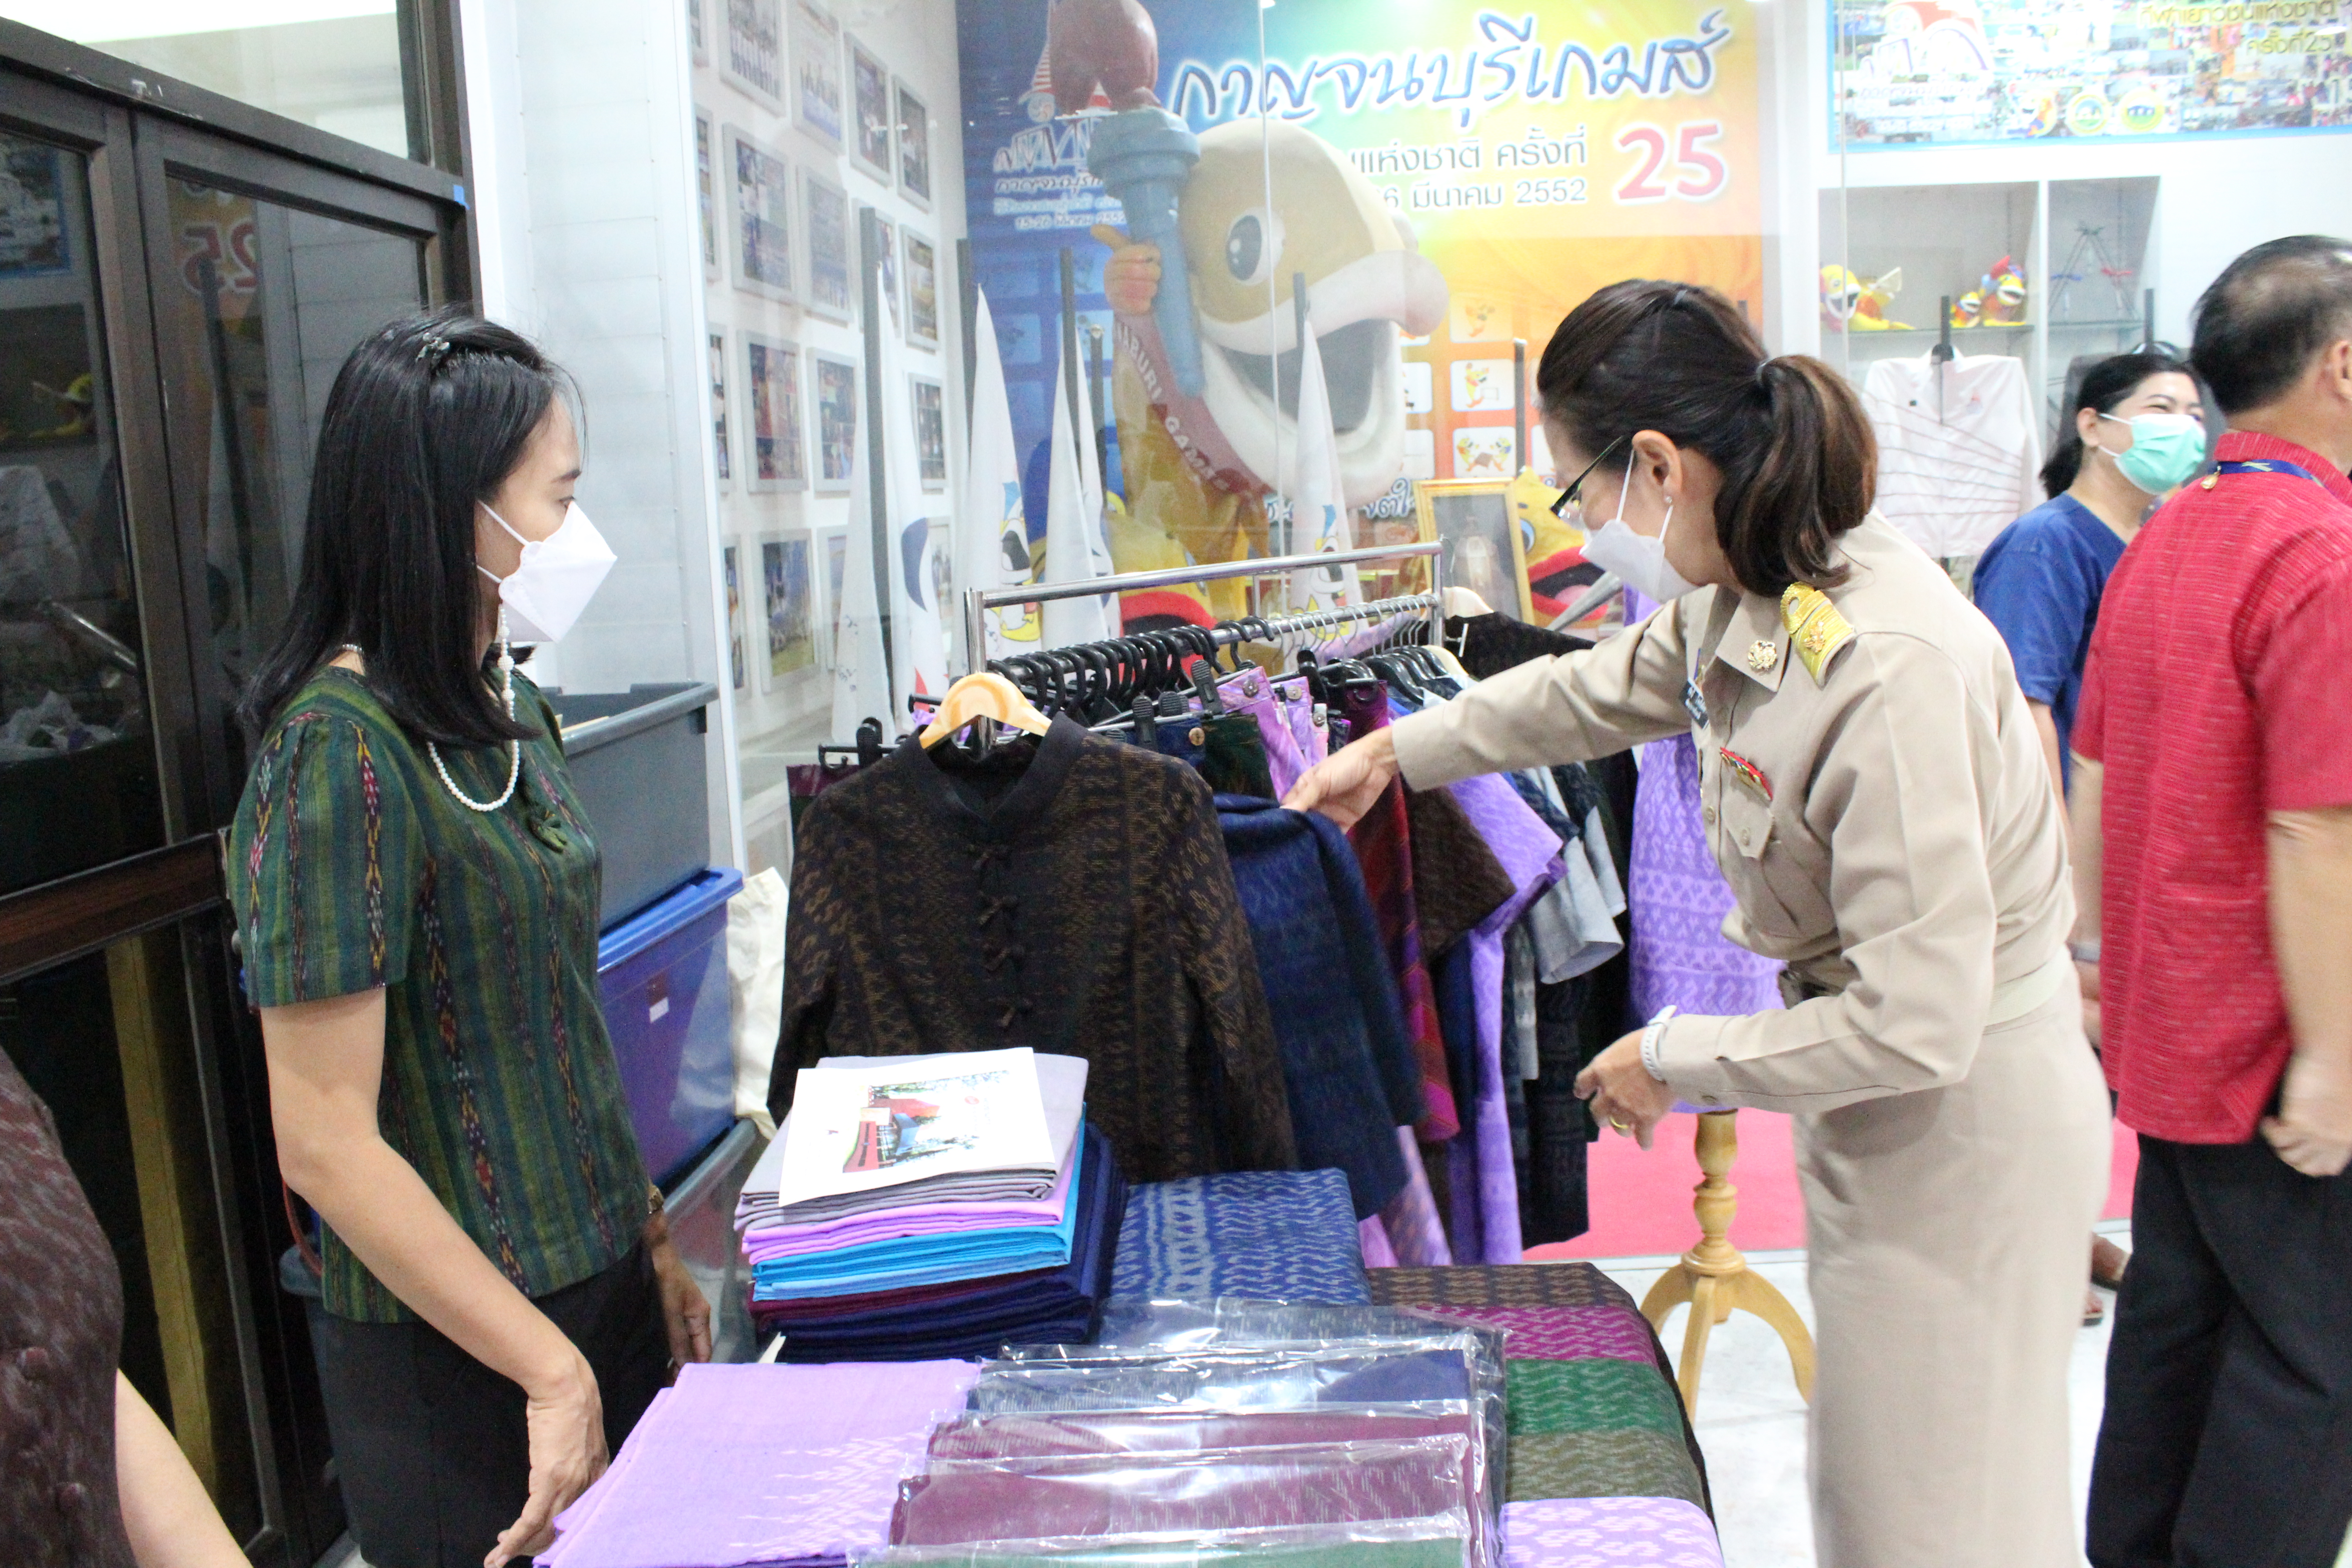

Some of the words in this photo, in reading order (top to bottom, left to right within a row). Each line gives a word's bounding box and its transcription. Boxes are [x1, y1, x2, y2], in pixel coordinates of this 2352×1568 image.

[1175, 10, 1731, 127] กาญจนบุรีเกมส์
[1413, 181, 1503, 208] มีนาคม
[1516, 179, 1587, 204] 2552
[1497, 125, 1586, 167] ครั้งที่
[1618, 123, 1725, 201] 25
